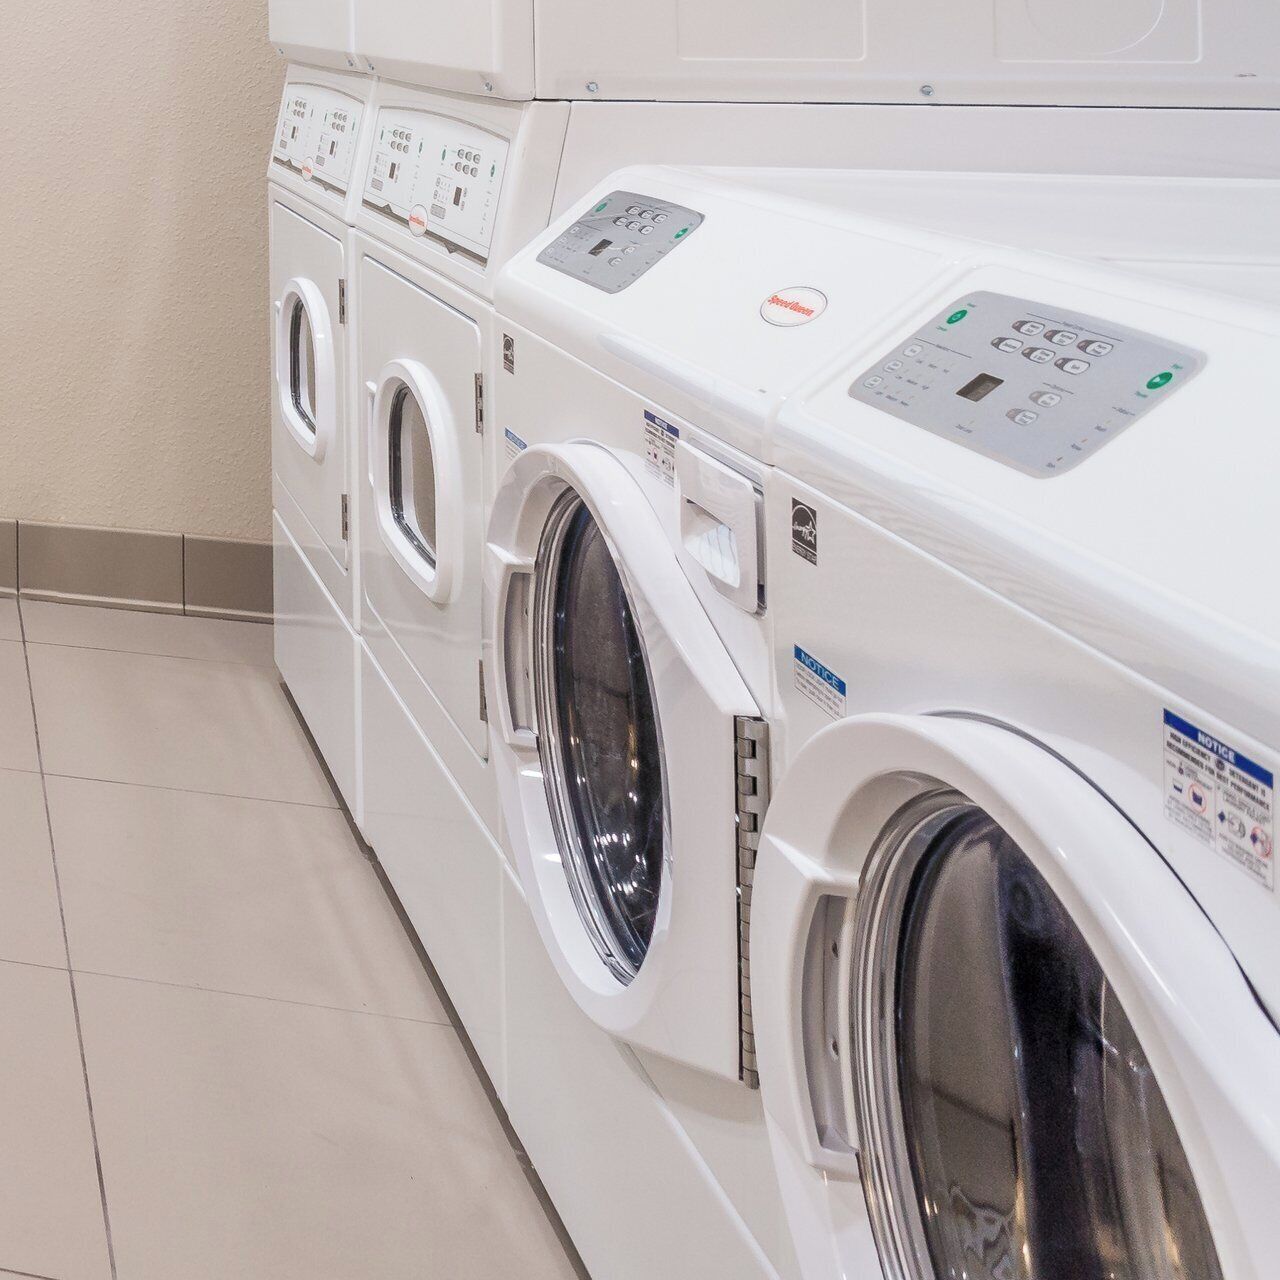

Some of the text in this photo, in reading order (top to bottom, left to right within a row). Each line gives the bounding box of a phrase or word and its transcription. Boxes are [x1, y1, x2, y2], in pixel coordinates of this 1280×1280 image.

[767, 294, 815, 317] Speed Queen
[800, 651, 840, 691] NOTICE
[1197, 730, 1236, 764] NOTICE
